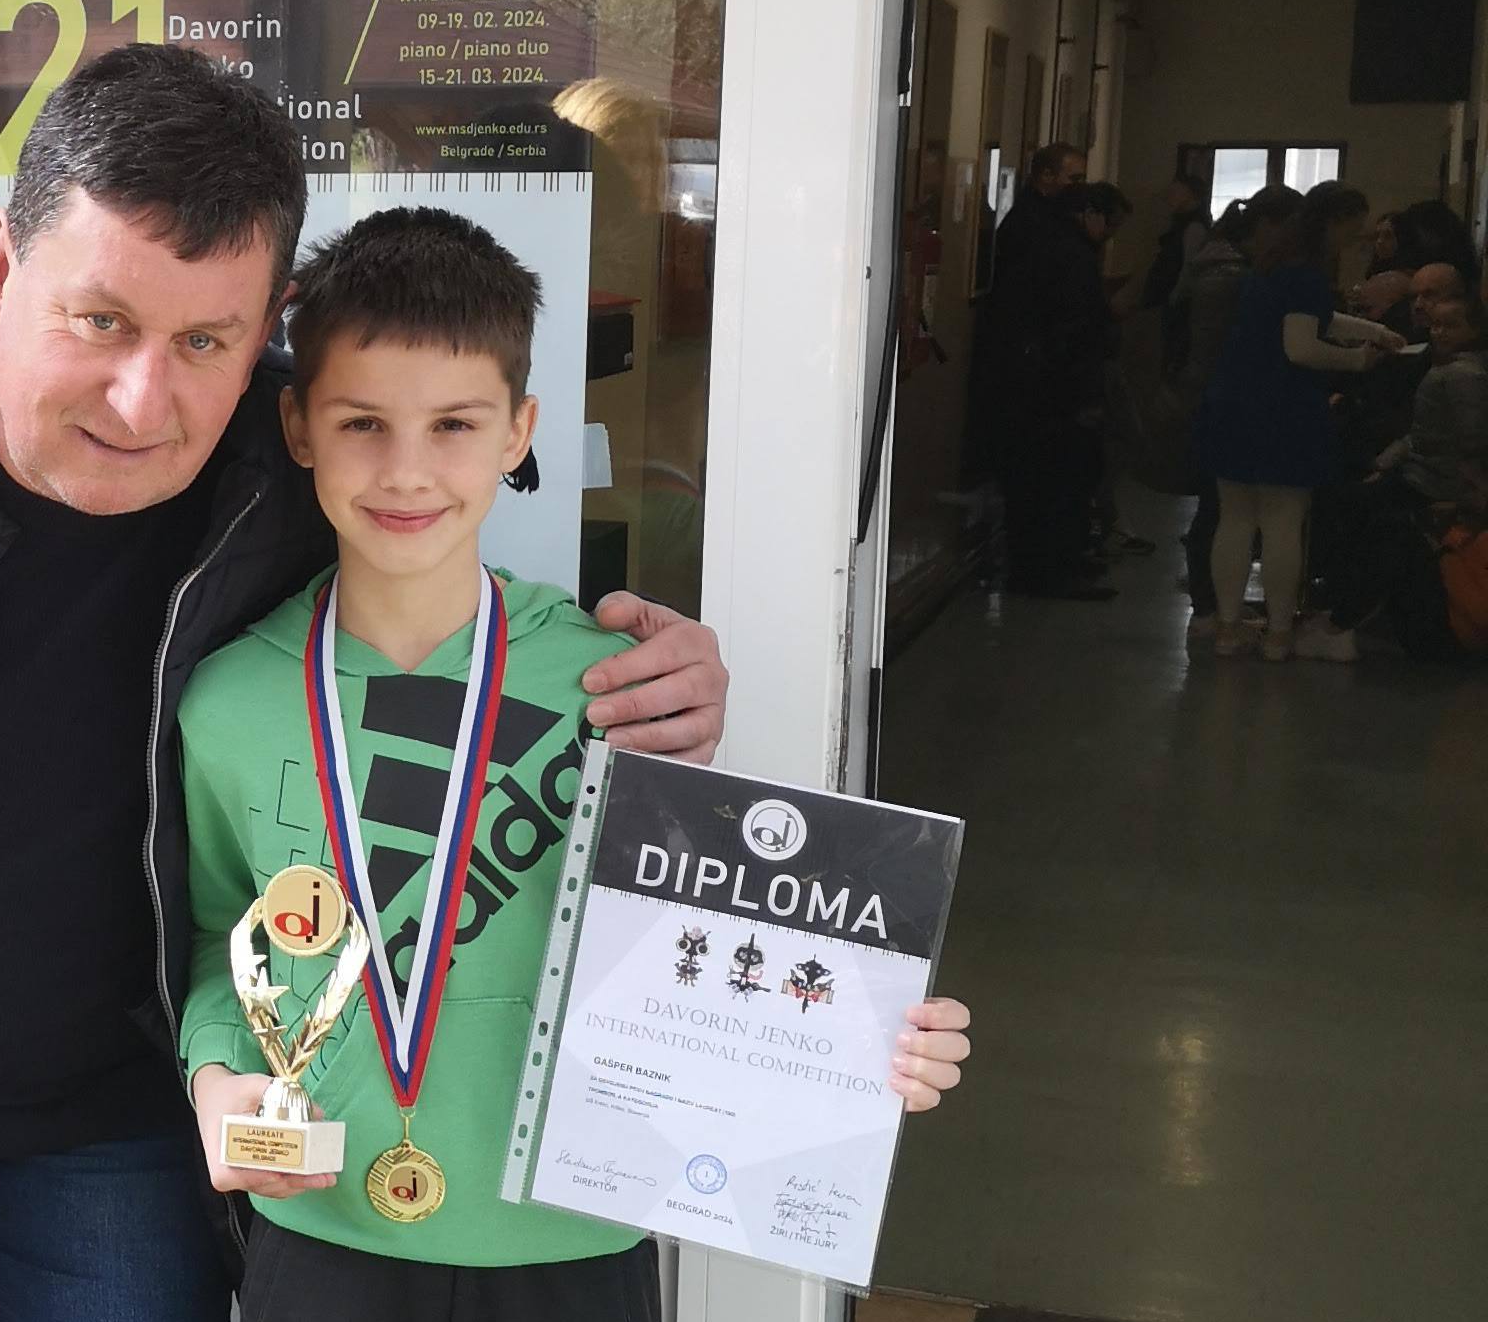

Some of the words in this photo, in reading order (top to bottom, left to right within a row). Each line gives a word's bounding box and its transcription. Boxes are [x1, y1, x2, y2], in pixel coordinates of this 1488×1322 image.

[169, 13, 281, 40] Davorin
[418, 12, 467, 29] 09-19.
[473, 12, 498, 28] 02.
[504, 10, 550, 27] 2024.
[399, 41, 446, 62] piano
[451, 39, 461, 60] /
[464, 40, 511, 60] piano
[517, 39, 549, 55] duo
[419, 68, 465, 85] 15-21.
[471, 68, 496, 84] 03.
[502, 67, 549, 84] 2024.
[415, 122, 548, 137] www.msdjenko.edu.rs
[440, 144, 495, 159] Belgrade
[497, 143, 505, 158] /
[507, 144, 546, 157] Serbia
[634, 843, 888, 939] DIPLOMA
[643, 997, 749, 1037] DAVORIN
[755, 1019, 833, 1057] JENKO
[585, 1013, 741, 1063] INTERNATIONAL
[747, 1051, 884, 1097] COMPETITION
[247, 1129, 284, 1138] LAUREATE
[572, 1174, 618, 1194] DIREKTOR
[666, 1199, 712, 1219] BEOGRAD
[795, 1232, 812, 1244] THE
[814, 1237, 839, 1250] JURY
